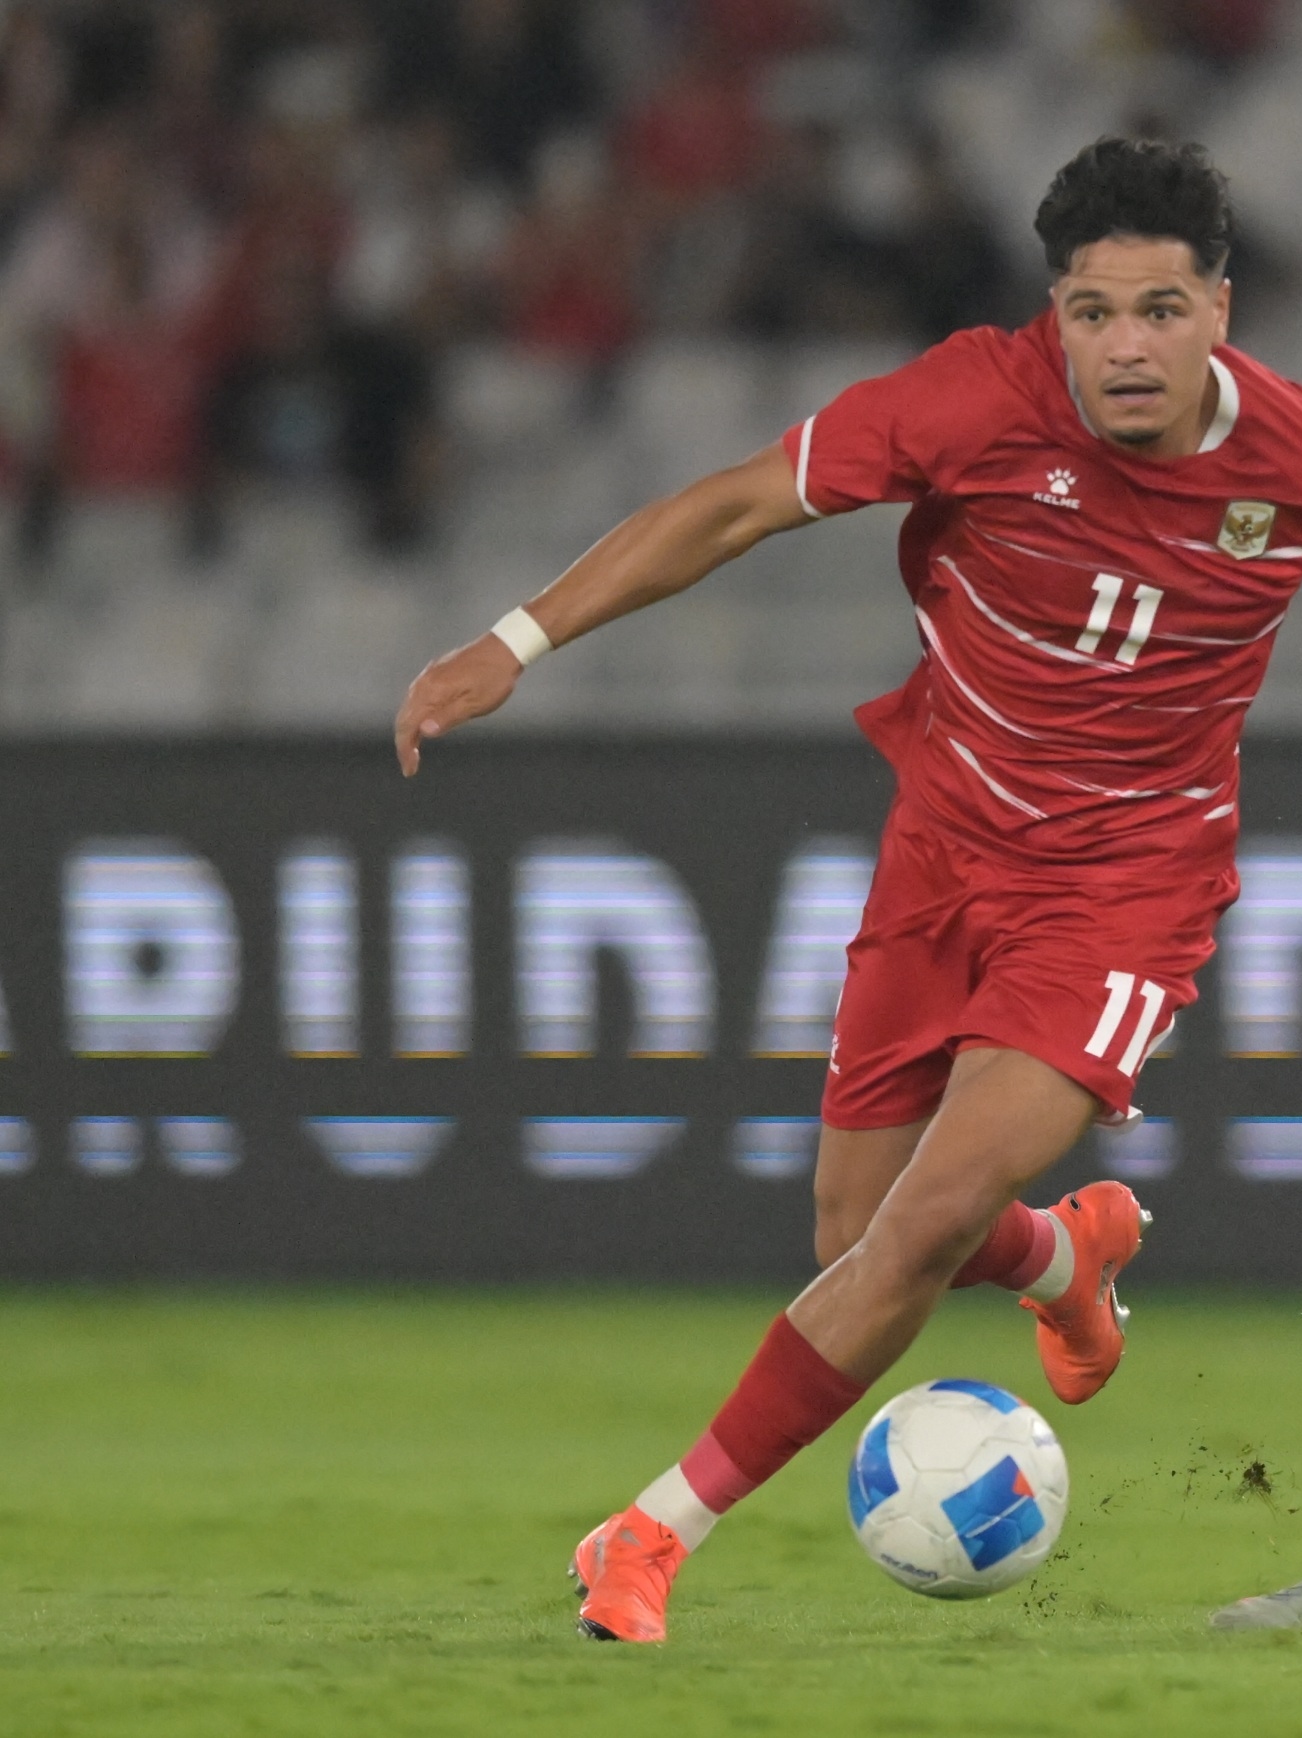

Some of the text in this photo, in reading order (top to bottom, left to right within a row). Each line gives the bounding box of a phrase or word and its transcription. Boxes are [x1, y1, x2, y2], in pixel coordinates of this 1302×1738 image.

[1033, 492, 1081, 510] KELME
[1075, 573, 1164, 666] 11
[1084, 970, 1166, 1078] 11
